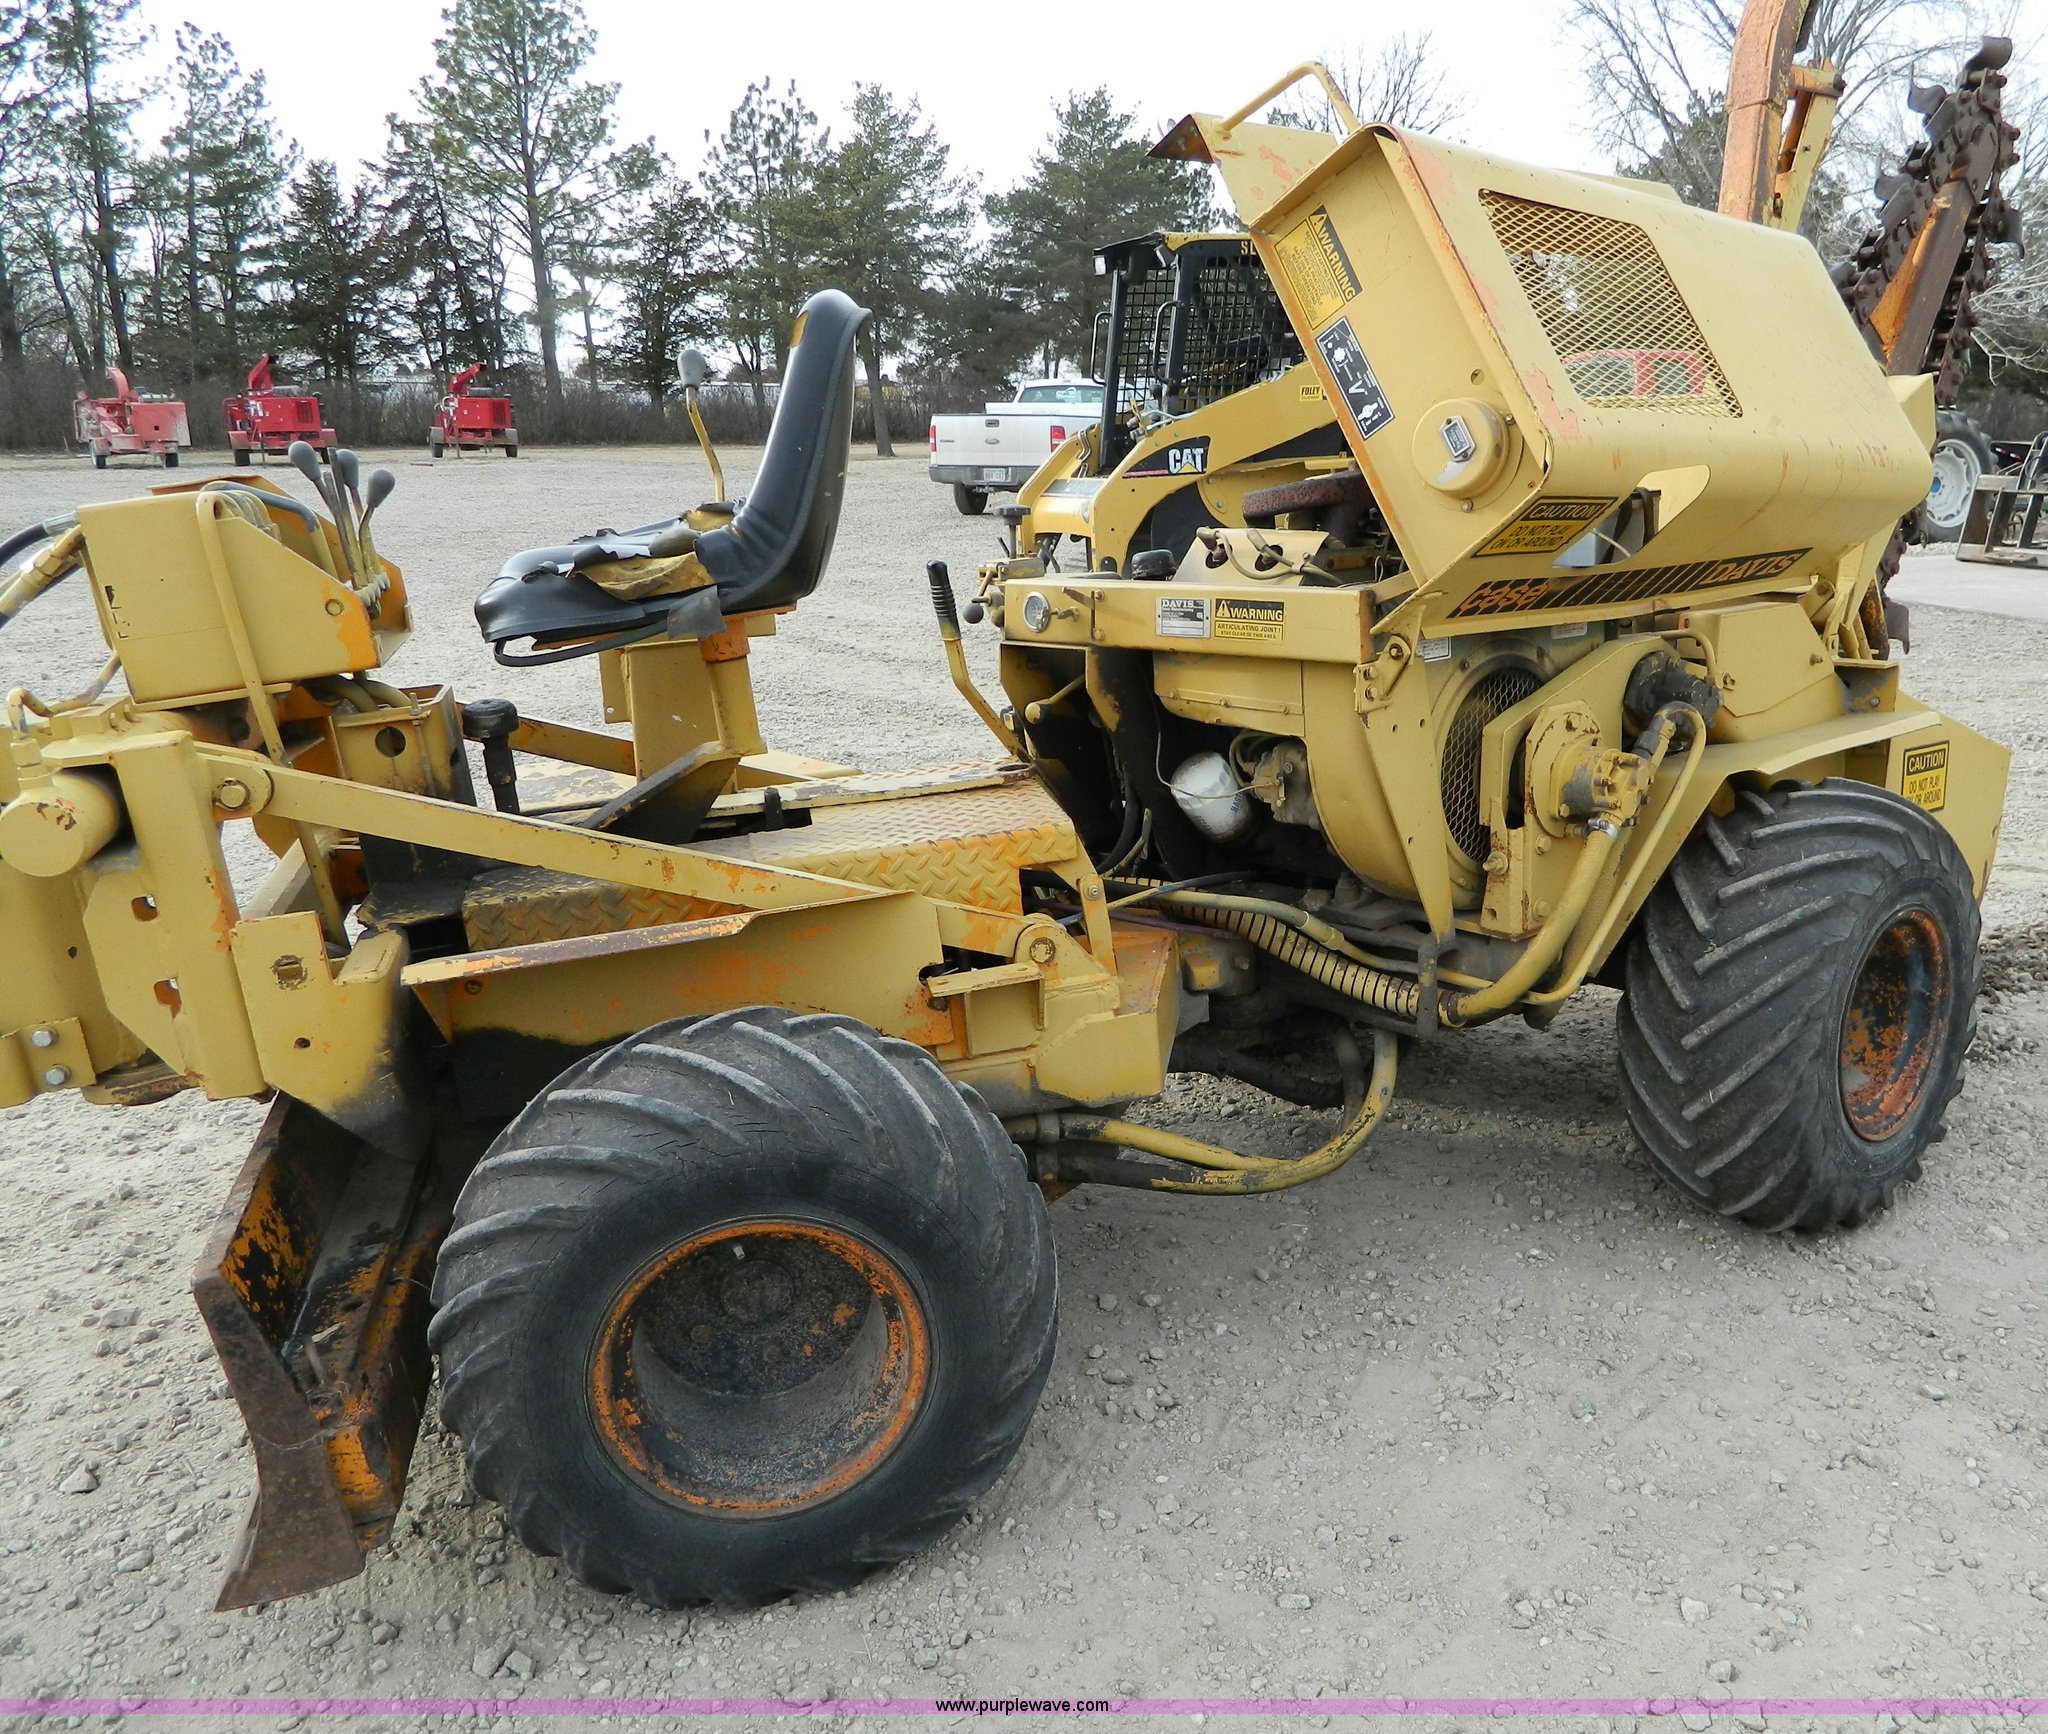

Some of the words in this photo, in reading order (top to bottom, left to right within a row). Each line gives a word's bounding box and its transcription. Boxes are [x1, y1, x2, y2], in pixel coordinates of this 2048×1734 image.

[1315, 225, 1357, 300] WARNING
[1168, 448, 1204, 474] CAT
[1530, 505, 1601, 518] CAUTION
[1528, 526, 1550, 536] NOT
[1523, 537, 1563, 547] AROUND
[1699, 553, 1803, 585] DAVIS
[1230, 608, 1282, 621] WARNING
[1909, 751, 1944, 772] CAUTION
[1909, 781, 1917, 793] DO
[1919, 778, 1928, 791] NOT
[1929, 775, 1940, 788] PLAY
[1923, 789, 1941, 804] AROUND
